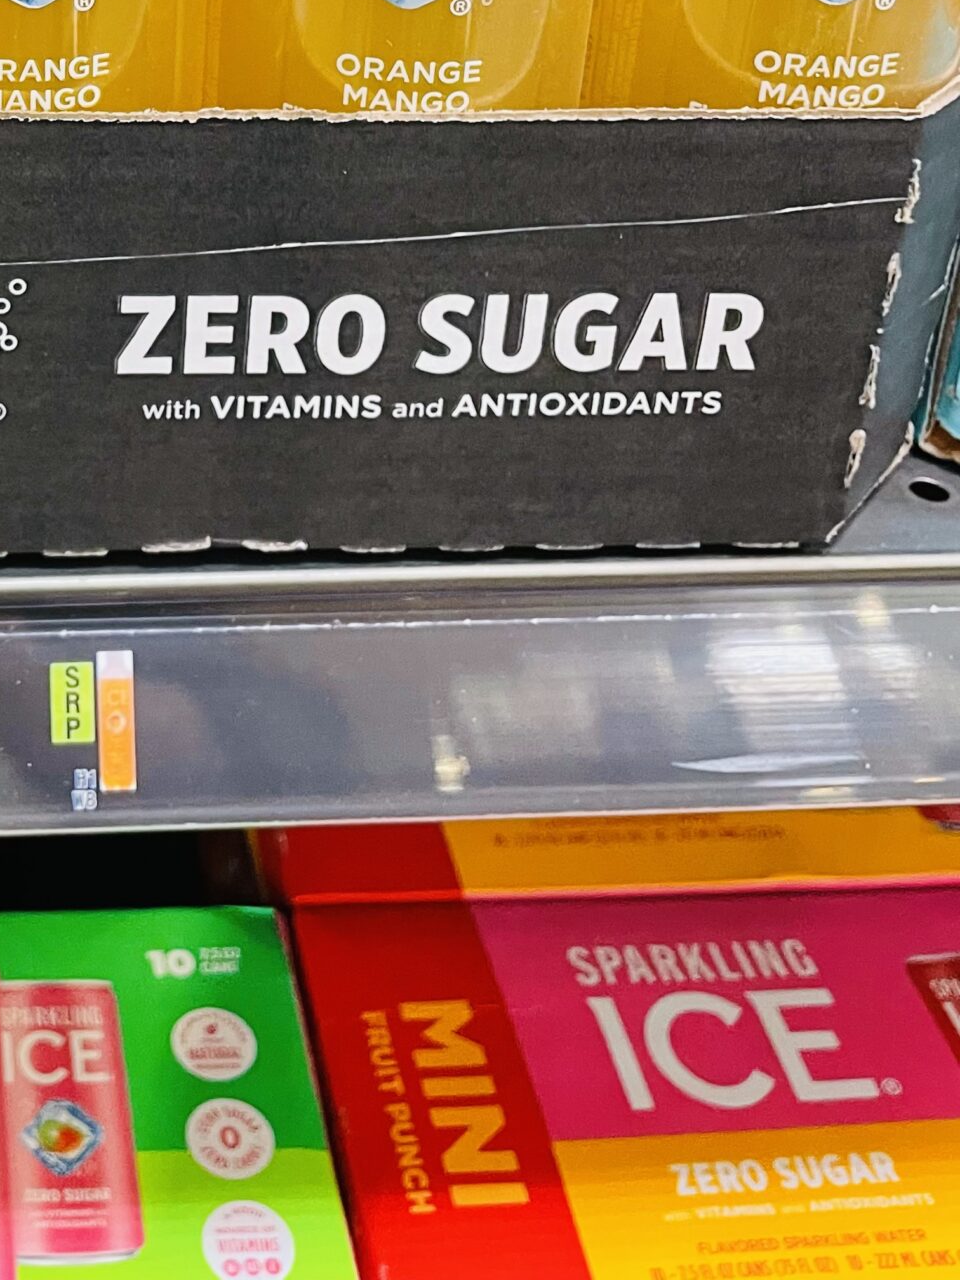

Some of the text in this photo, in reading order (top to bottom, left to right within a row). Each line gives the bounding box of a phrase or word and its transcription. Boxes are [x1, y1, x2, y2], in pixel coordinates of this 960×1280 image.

[336, 53, 483, 85] ORANGE
[754, 50, 900, 79] ORANGE
[342, 83, 470, 113] MANGO
[758, 80, 885, 110] MANGO
[115, 292, 765, 376] ZERO SUGAR
[143, 390, 723, 420] with VITAMINS and ANTIOXIDANTS
[145, 948, 197, 980] 10
[566, 939, 820, 988] SPARKLING
[1, 1029, 113, 1085] ICE
[585, 988, 881, 1112] ICE
[360, 1010, 437, 1214] FRUIT PUNCH
[398, 998, 531, 1208] MINI
[668, 1151, 901, 1197] ZERO SUGAR
[695, 1203, 776, 1219] VITAMINS
[809, 1192, 935, 1213] ANTIOXIDANTS
[697, 1227, 927, 1255] FLAVORED SPARKLING WATER
